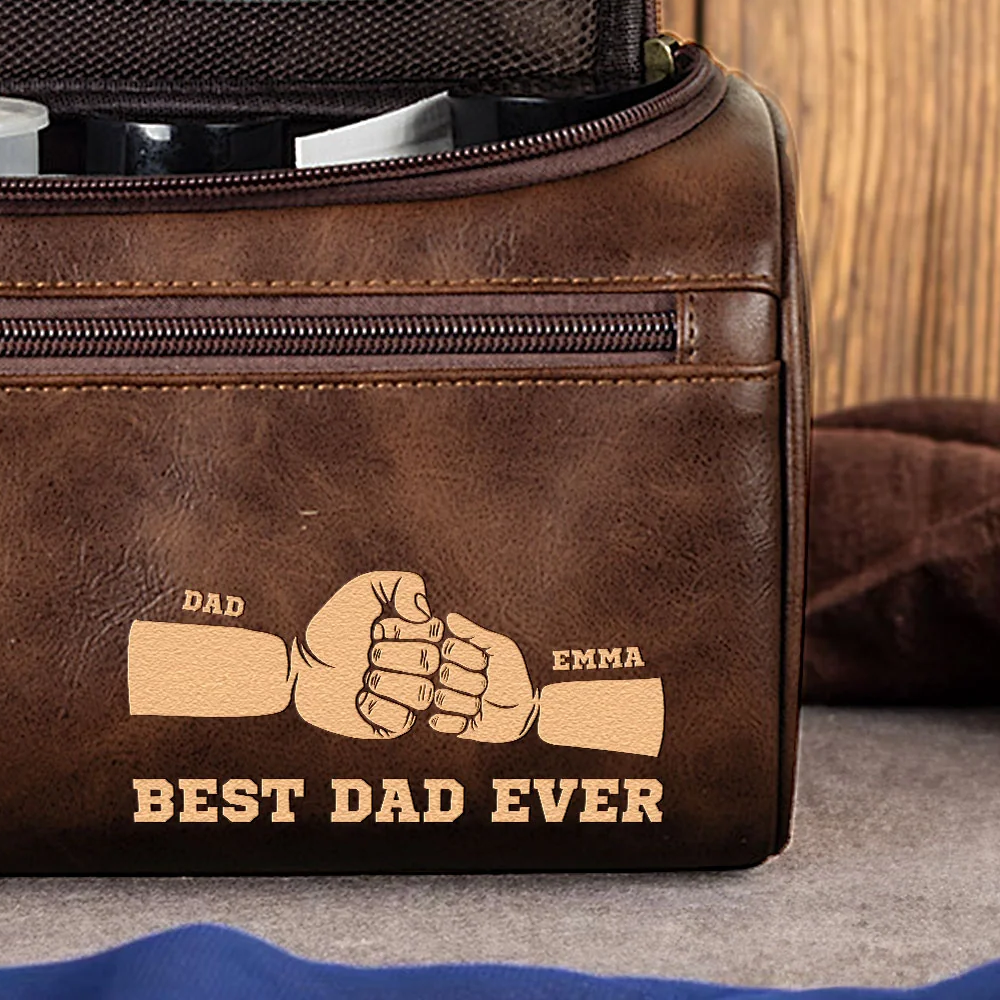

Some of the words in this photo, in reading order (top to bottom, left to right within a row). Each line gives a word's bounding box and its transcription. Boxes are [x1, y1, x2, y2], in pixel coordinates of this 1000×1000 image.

[182, 589, 245, 618] DAD
[552, 646, 645, 671] EMMA
[133, 778, 305, 823] BEST
[331, 778, 464, 823] DAD
[492, 778, 663, 823] EVER
